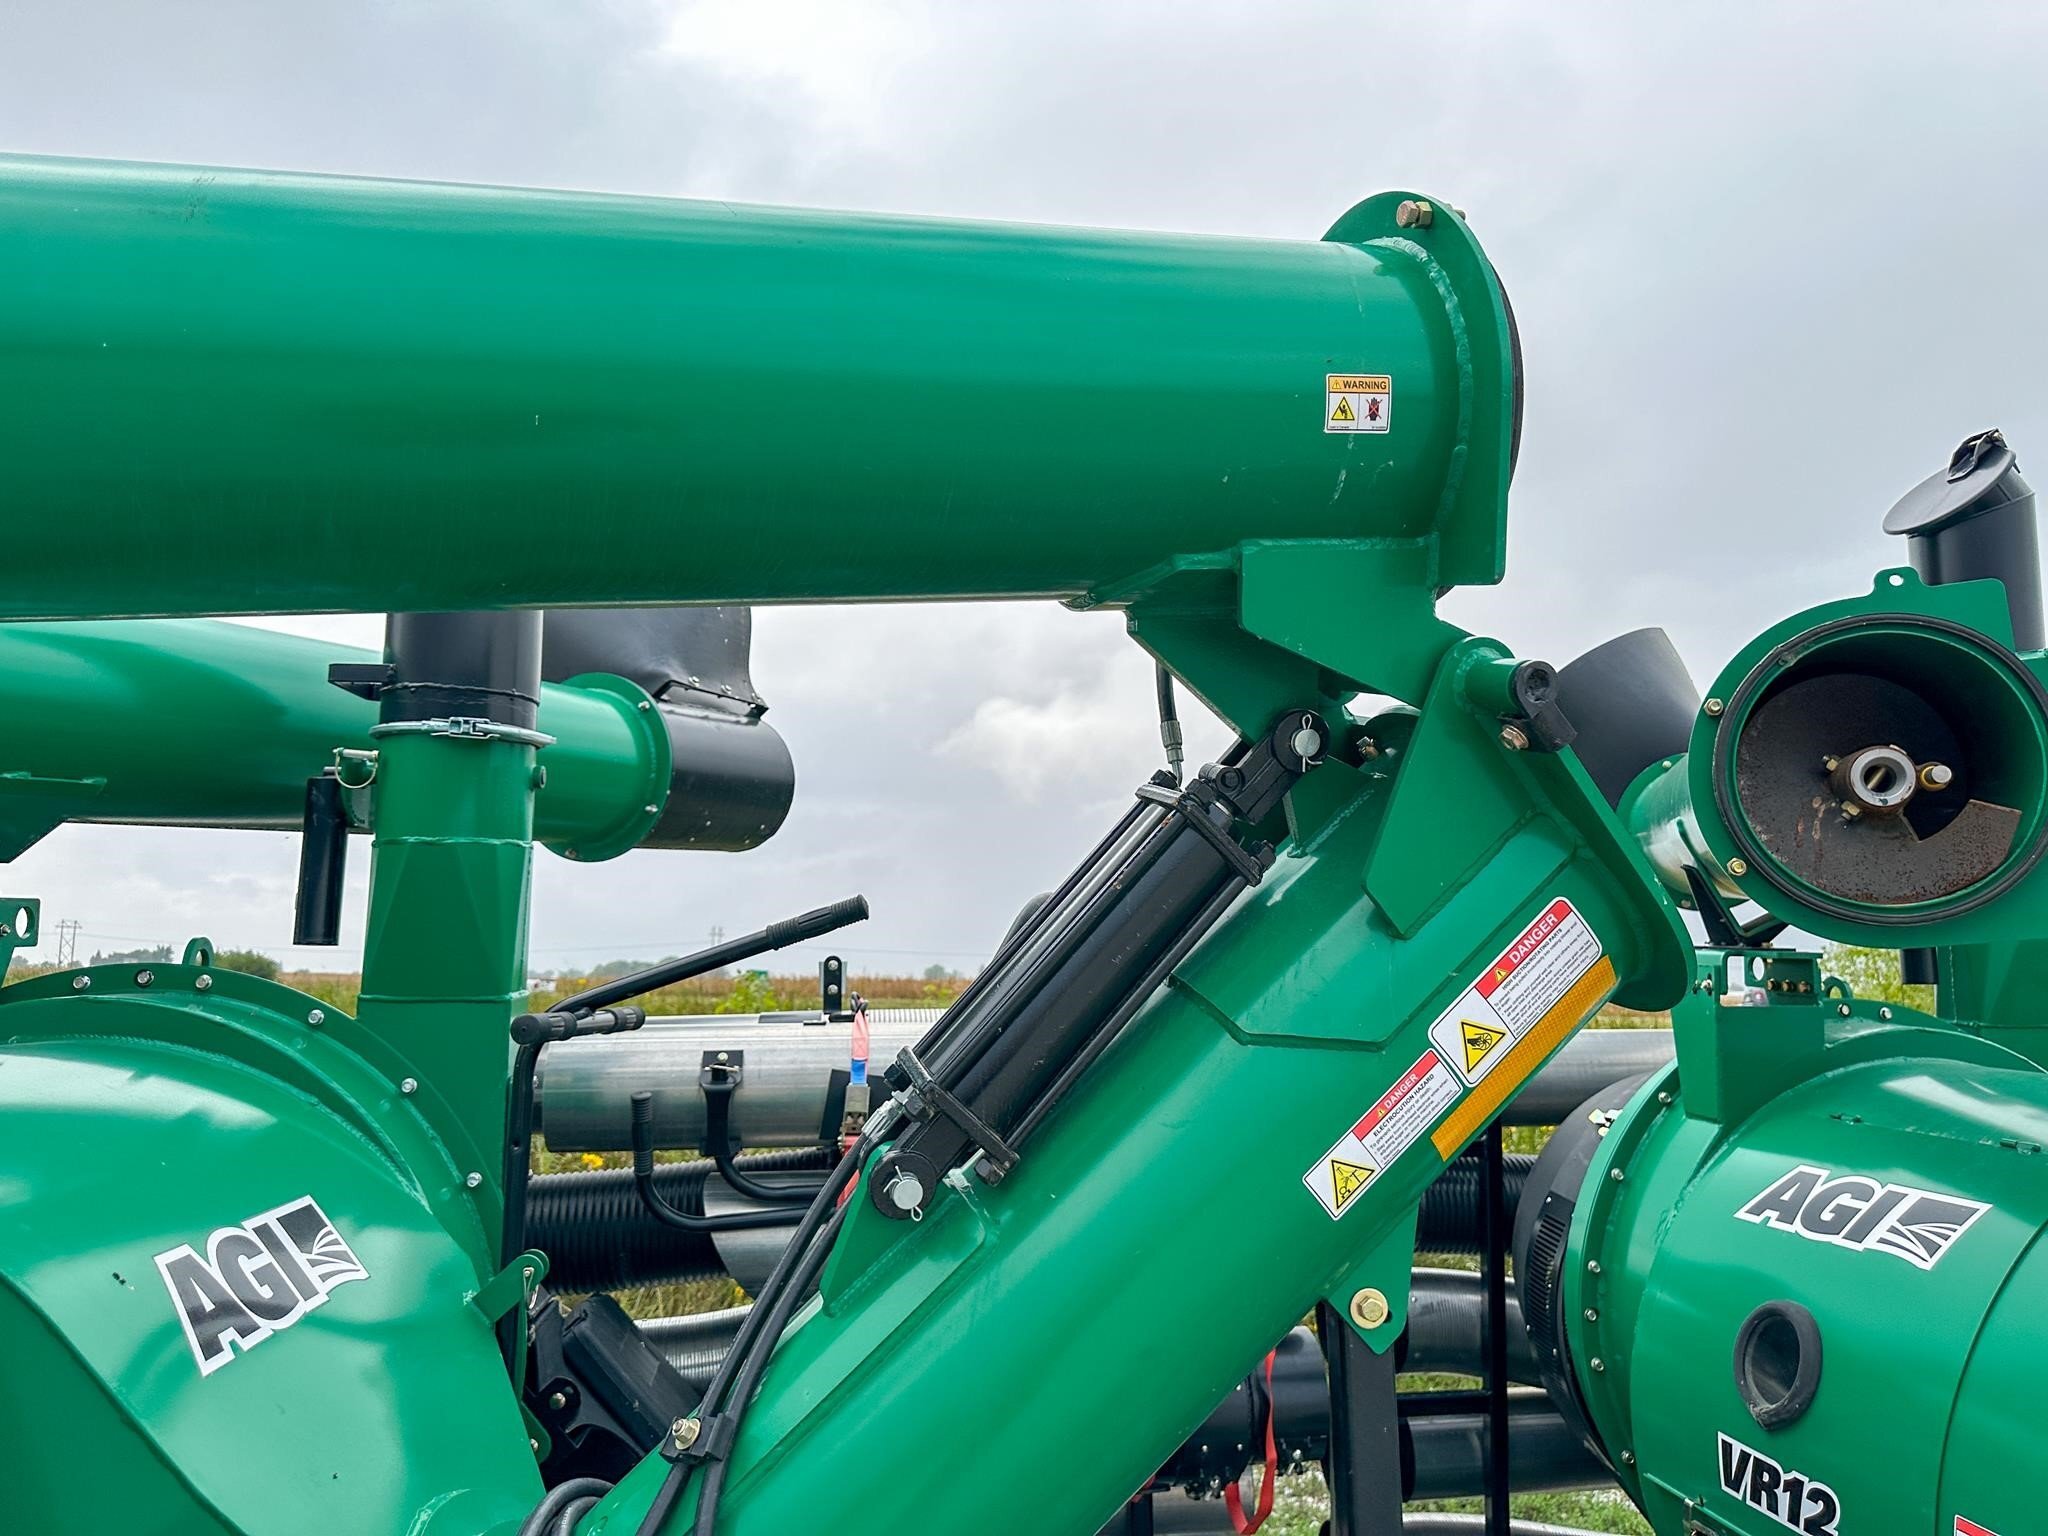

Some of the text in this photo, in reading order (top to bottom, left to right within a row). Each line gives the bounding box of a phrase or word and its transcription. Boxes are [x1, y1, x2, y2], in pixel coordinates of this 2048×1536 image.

[1342, 380, 1387, 390] WARNING
[1509, 914, 1558, 964] DANGER
[1548, 928, 1562, 942] PARTS
[1373, 1094, 1414, 1136] ELECTROCUTION
[1413, 1073, 1434, 1095] HAZARD
[1384, 1073, 1419, 1109] DANGER
[1742, 1168, 1911, 1246] AGI
[164, 1221, 322, 1363] AGI
[1720, 1437, 1838, 1536] VR12
